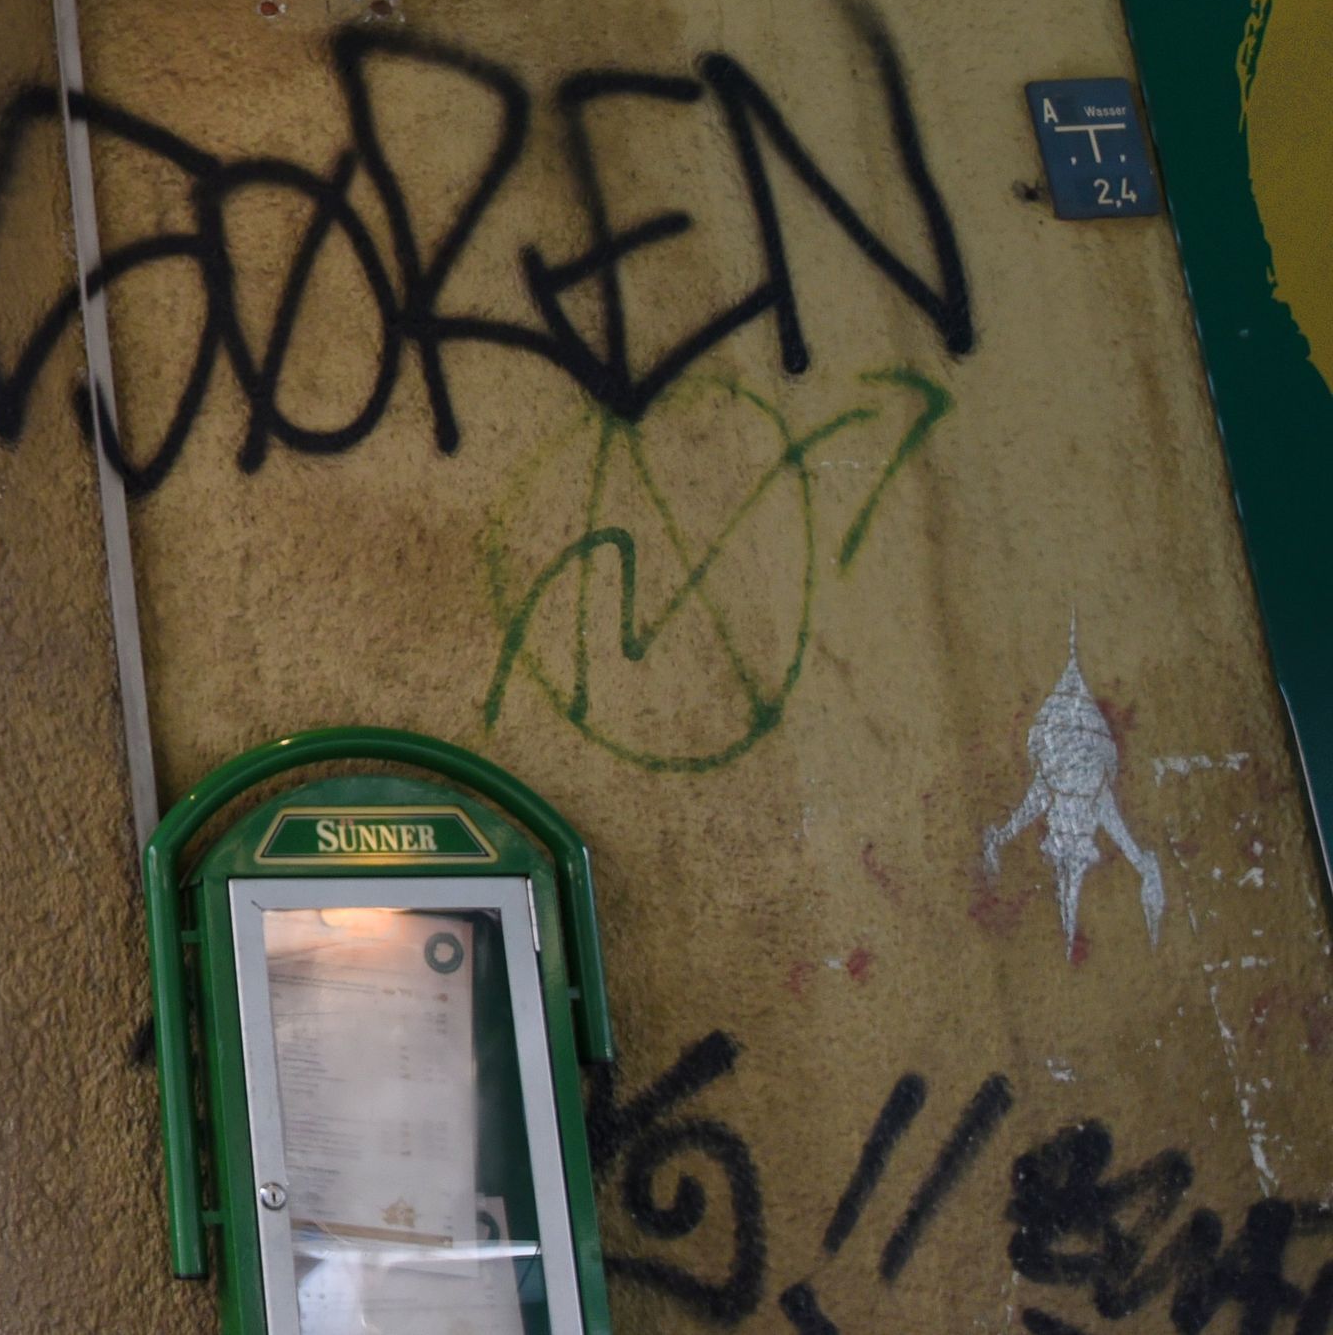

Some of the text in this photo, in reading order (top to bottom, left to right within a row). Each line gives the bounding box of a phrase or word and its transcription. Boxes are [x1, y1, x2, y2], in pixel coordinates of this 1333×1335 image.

[1042, 97, 1059, 124] A
[1083, 105, 1127, 117] Wasser
[316, 817, 438, 853] SÜNNER
